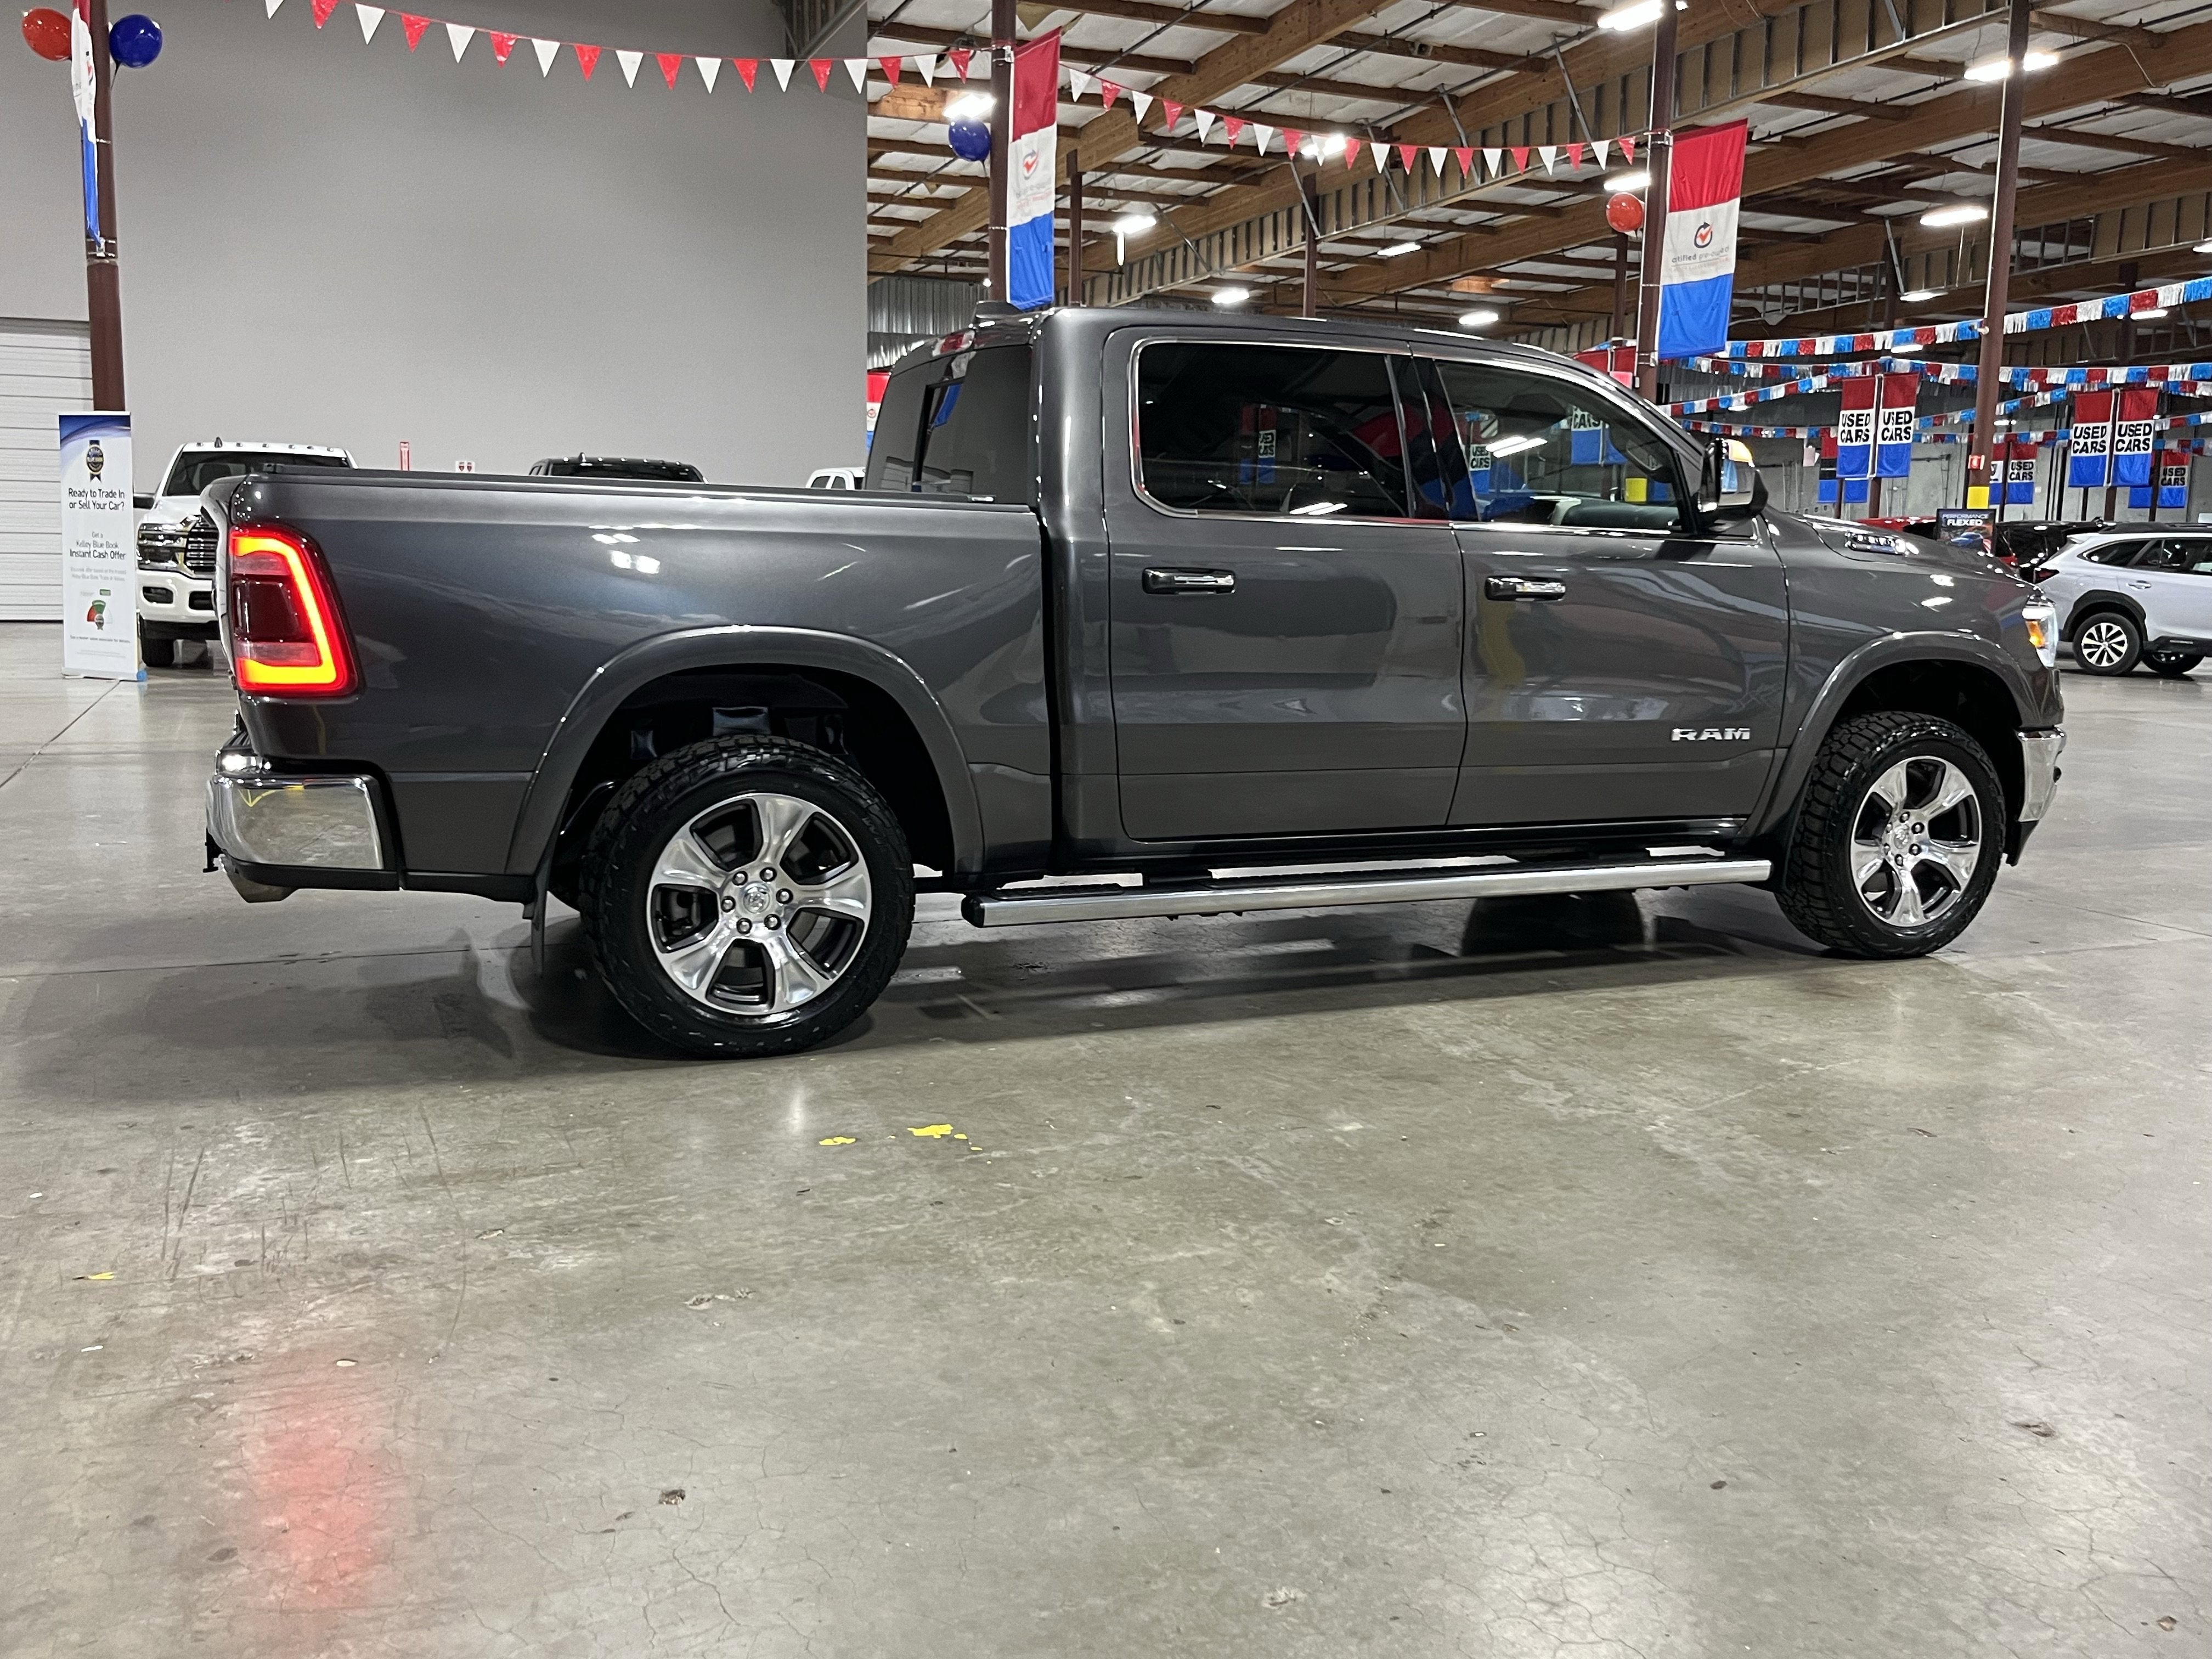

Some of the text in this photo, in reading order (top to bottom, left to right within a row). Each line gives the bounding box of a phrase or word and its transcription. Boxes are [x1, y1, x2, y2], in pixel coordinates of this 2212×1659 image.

[1842, 413, 1870, 427] USED
[1883, 411, 1912, 425] USED
[1841, 428, 1870, 443] CARS
[1881, 426, 1911, 441] CARS
[2073, 426, 2107, 439] USED
[2117, 423, 2152, 437] USED
[2073, 440, 2106, 454] CARS
[2115, 438, 2150, 452] CARS
[2011, 461, 2034, 471] USED
[2163, 467, 2186, 476] USED
[2009, 472, 2033, 481] CARS
[2160, 477, 2185, 486] CARS
[69, 488, 88, 500] Ready
[98, 489, 117, 498] Trade
[119, 489, 125, 498] In
[78, 500, 91, 509] Sell
[92, 500, 107, 510] Your
[109, 501, 125, 511] Car?
[70, 549, 126, 560] Instant Cash Offer
[1671, 728, 1751, 741] RAM
